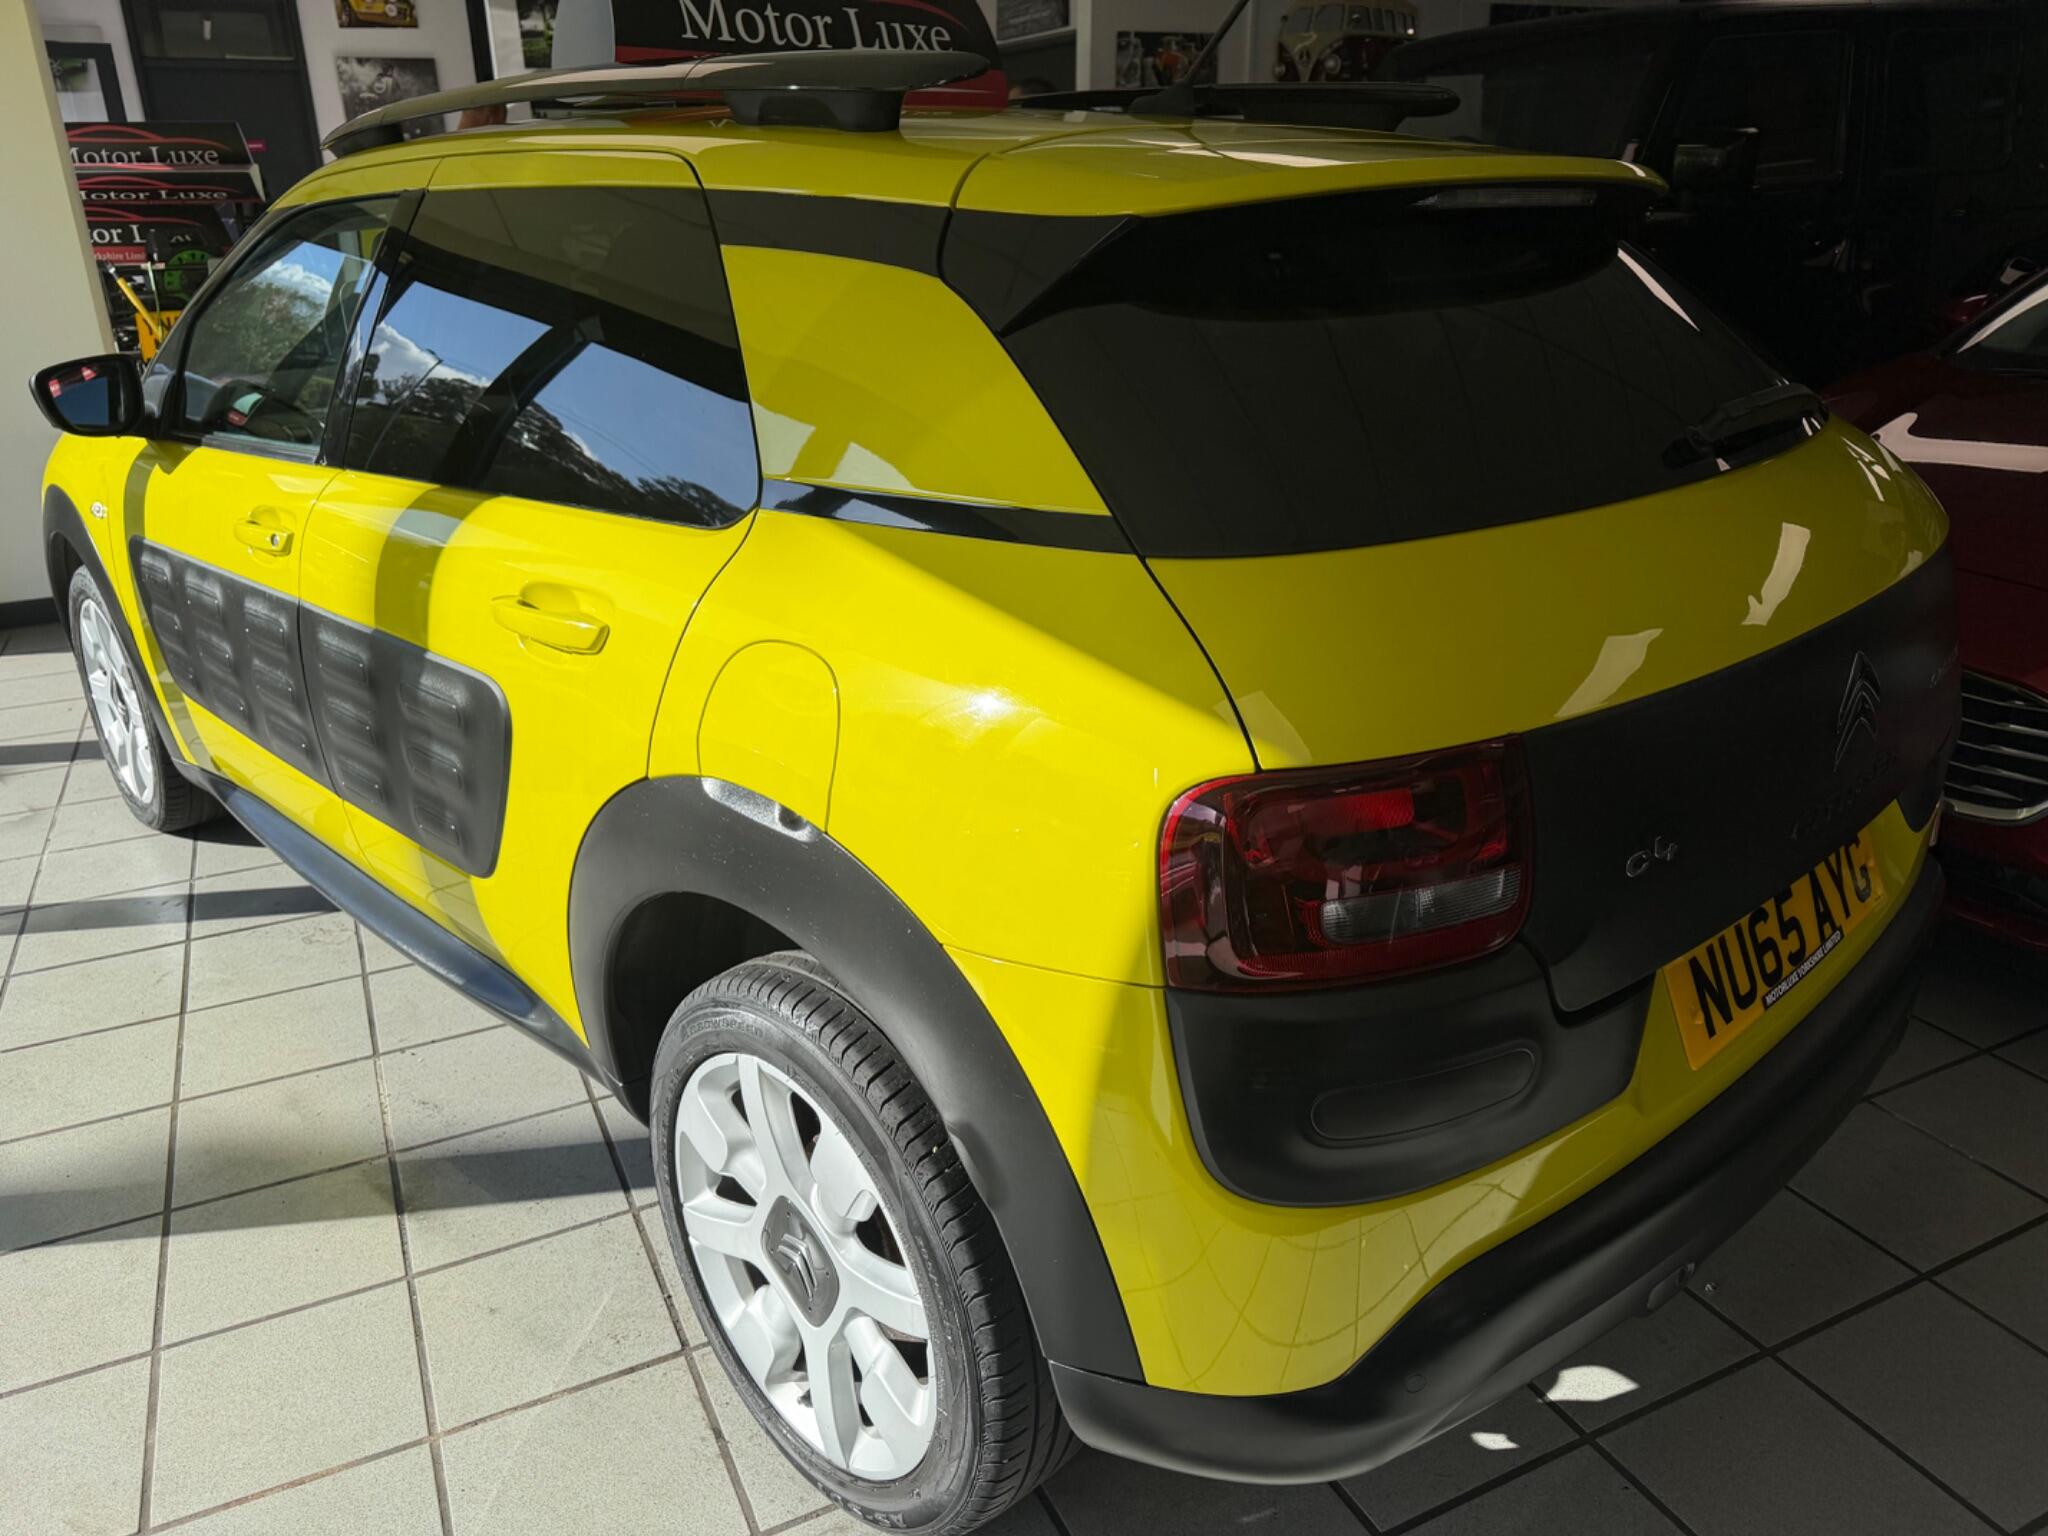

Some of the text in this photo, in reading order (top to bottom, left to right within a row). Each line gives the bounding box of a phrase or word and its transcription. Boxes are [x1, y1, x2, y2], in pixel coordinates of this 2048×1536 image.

[679, 0, 952, 51] Motor Luxe
[149, 146, 219, 165] Luxe
[159, 190, 228, 200] Luxe
[1626, 836, 1678, 878] C4
[1688, 836, 1872, 1040] NU65 AYG
[1765, 930, 1842, 1006] MOTORLUXE YORKSHIRE LIMITED
